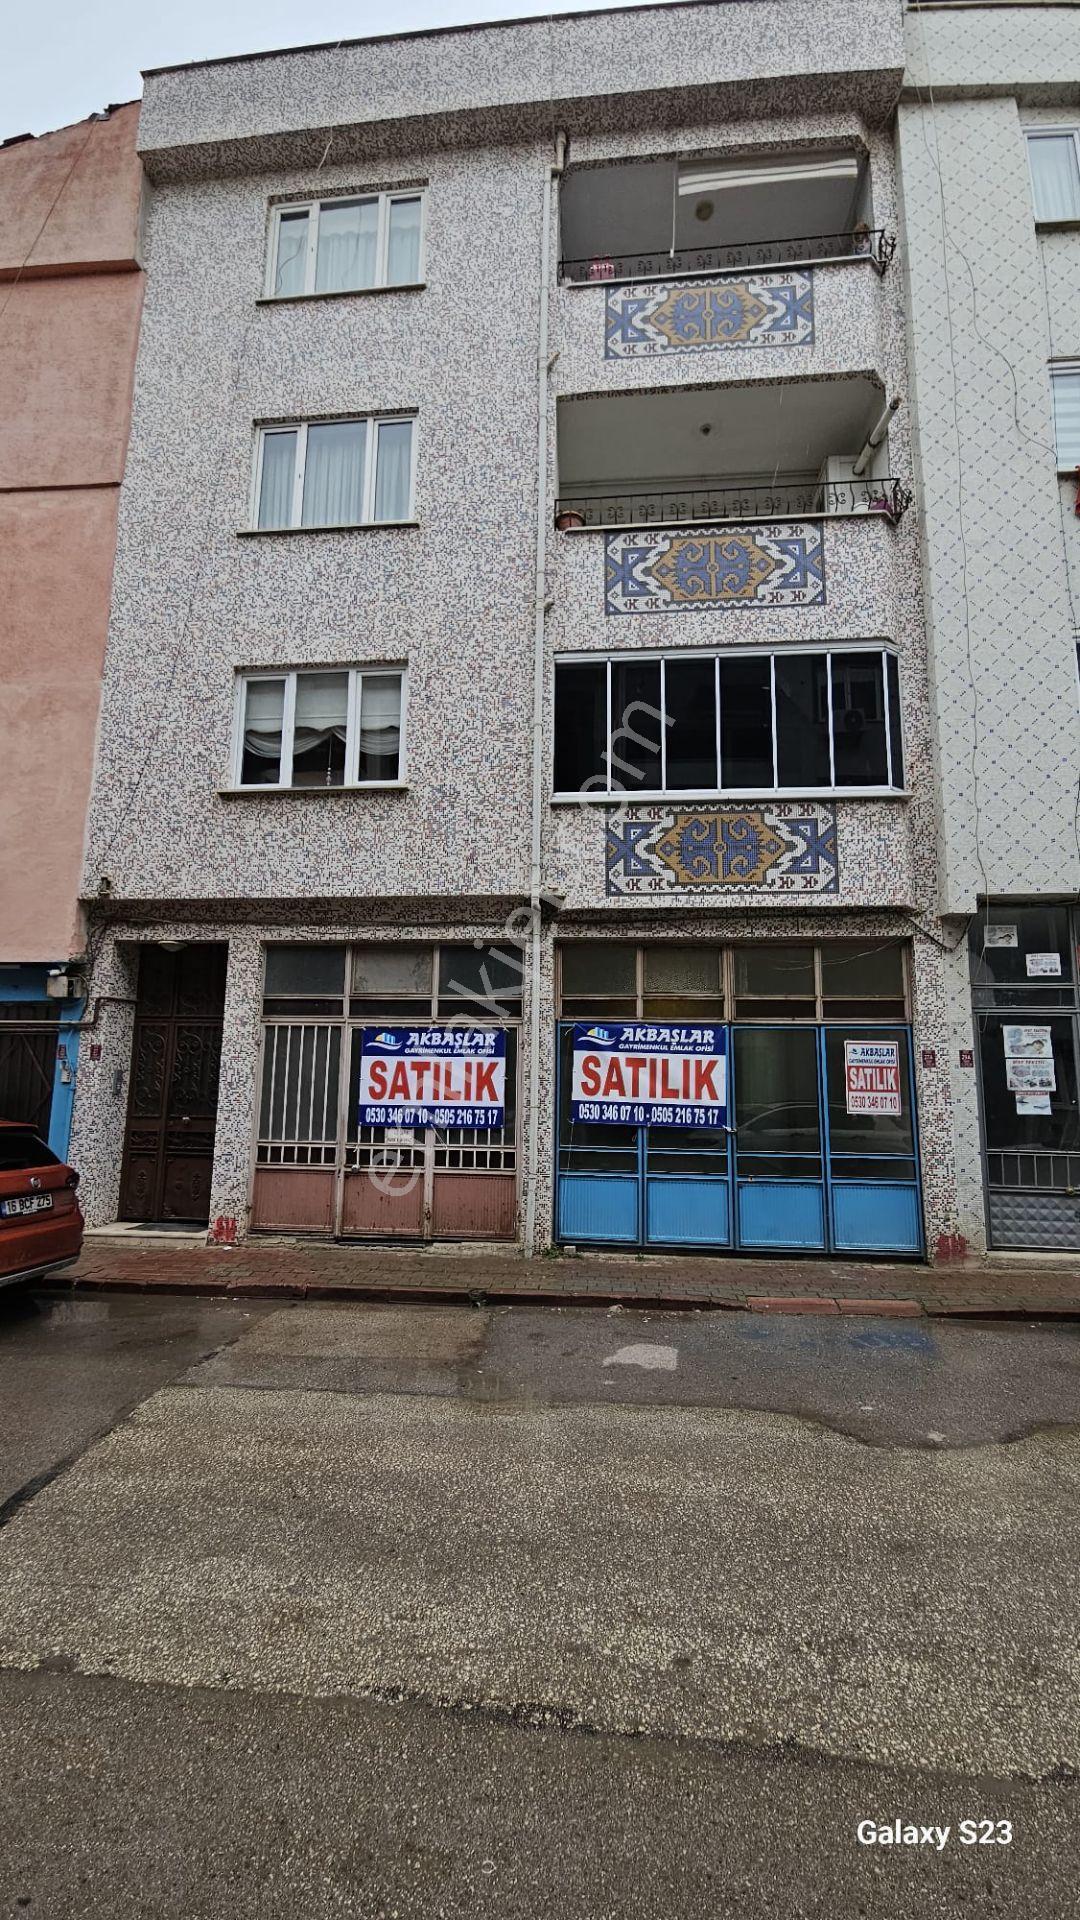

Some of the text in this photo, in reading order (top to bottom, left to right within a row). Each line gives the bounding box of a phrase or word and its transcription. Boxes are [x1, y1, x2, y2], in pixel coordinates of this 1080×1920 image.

[405, 1032, 496, 1048] AKBAŞLAR
[620, 1027, 715, 1045] AKBAŞLAR
[368, 1060, 499, 1101] SATILIK
[580, 1055, 719, 1101] SATILIK
[849, 1067, 897, 1091] SATILIK
[851, 1095, 865, 1108] 0530
[880, 1096, 888, 1108] 07
[890, 1096, 897, 1109] 10
[365, 1107, 386, 1123] 0530
[387, 1108, 403, 1123] 346
[404, 1108, 415, 1123] 07
[417, 1109, 428, 1124] 10
[434, 1109, 455, 1125] 0505
[456, 1109, 473, 1125] 216
[474, 1109, 485, 1124] 75
[487, 1109, 498, 1125] 17
[578, 1103, 600, 1120] 0530
[602, 1104, 618, 1121] 346
[620, 1105, 631, 1121] 07
[633, 1106, 644, 1122] 10
[651, 1107, 674, 1123] 0505
[675, 1107, 691, 1124] 216
[693, 1108, 705, 1124] 75
[707, 1109, 719, 1125] 17
[7, 1200, 17, 1212] 16
[36, 1194, 51, 1207] 275
